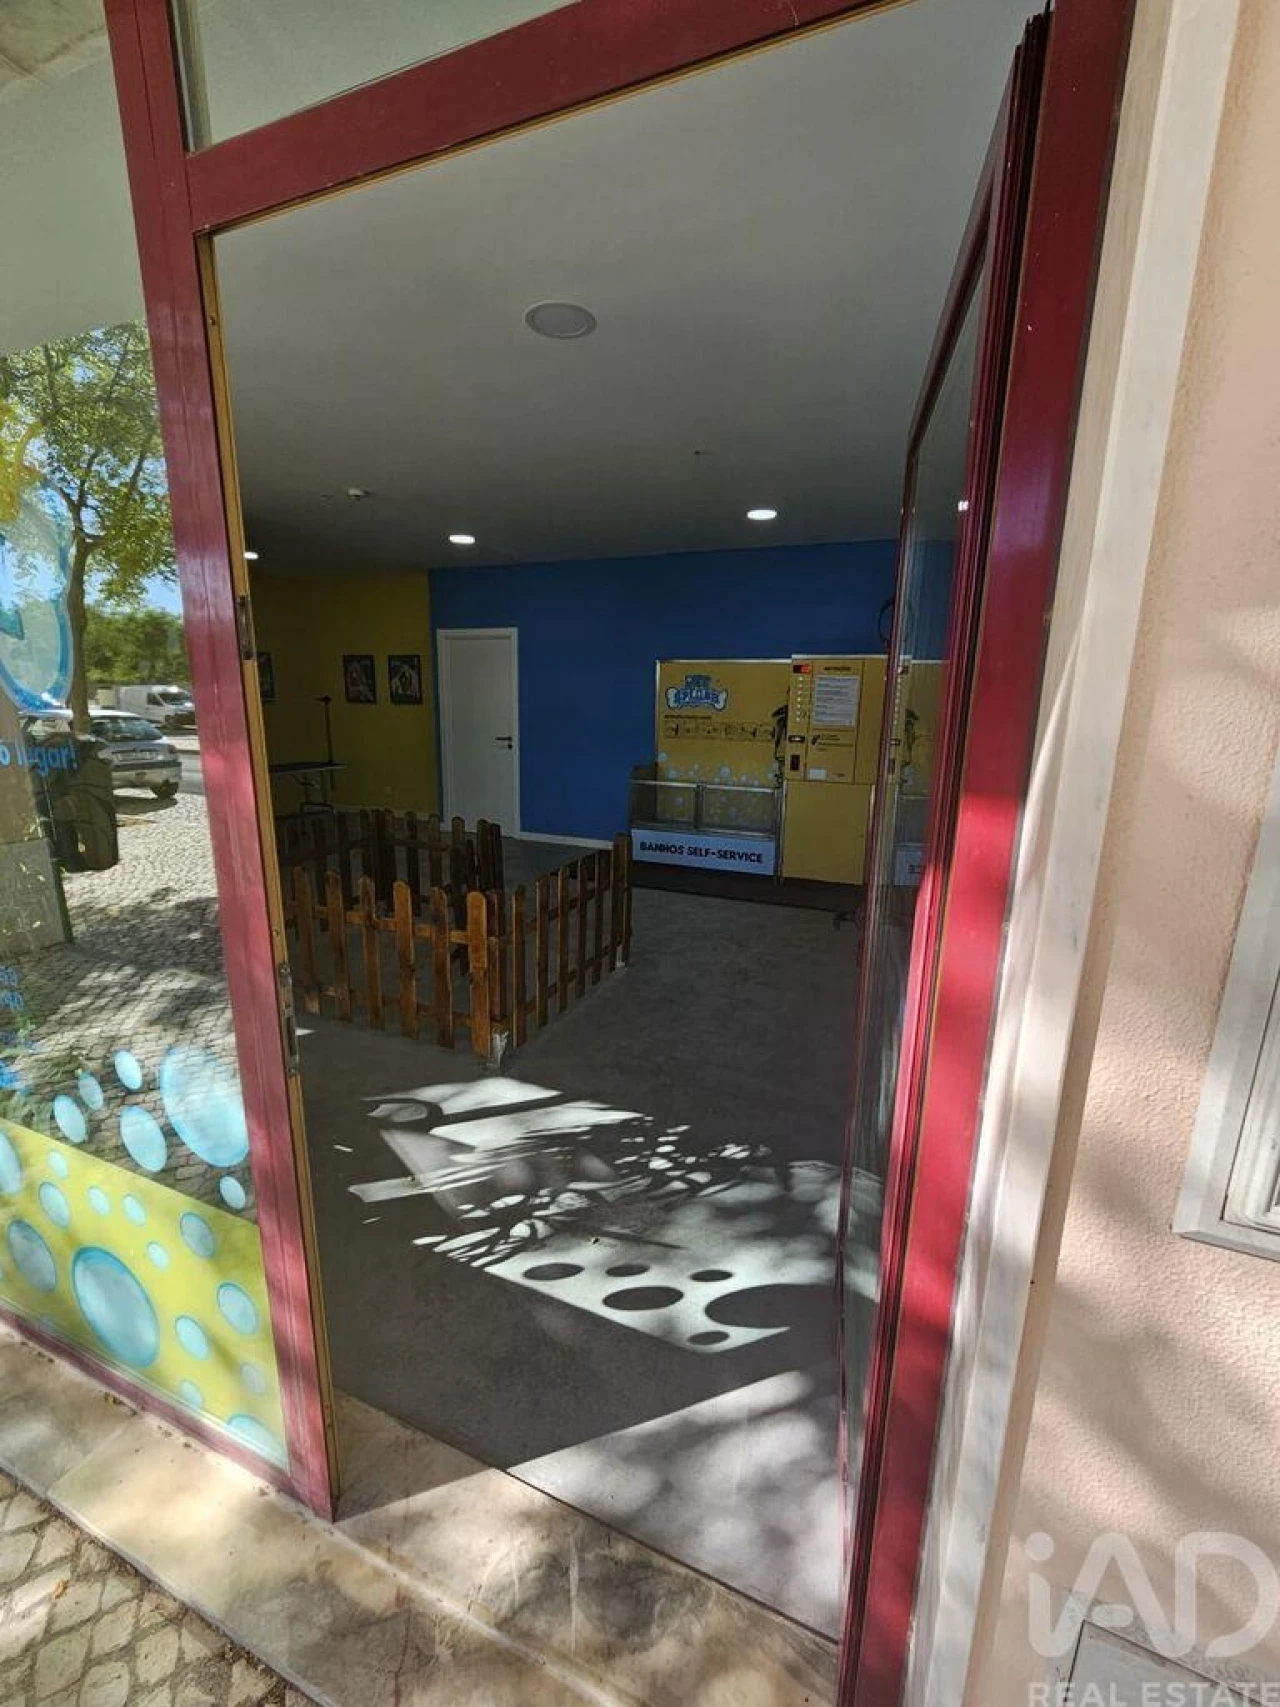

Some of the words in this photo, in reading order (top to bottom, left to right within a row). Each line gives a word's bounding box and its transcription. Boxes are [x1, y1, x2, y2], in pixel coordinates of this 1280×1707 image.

[15, 738, 78, 776] lugar!
[639, 841, 685, 856] BANHOS
[687, 846, 763, 863] SELF-SERVICE
